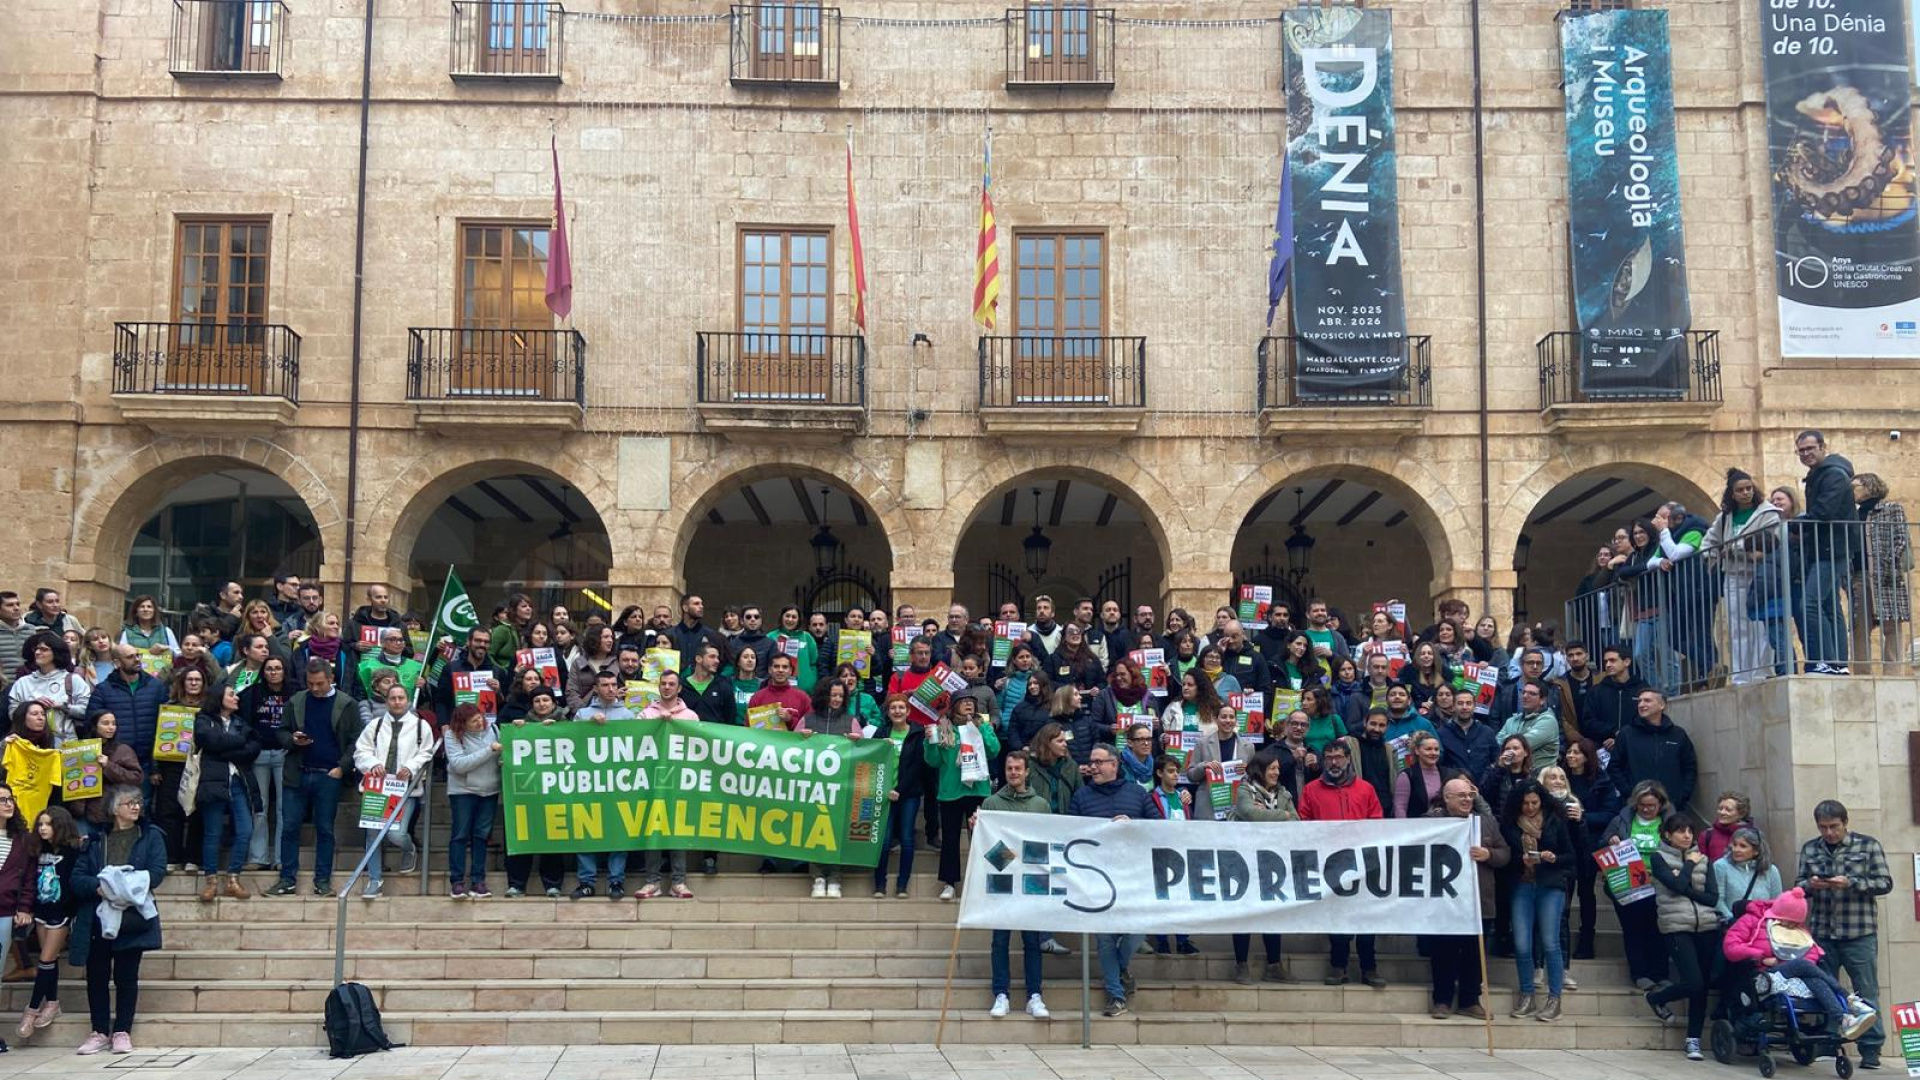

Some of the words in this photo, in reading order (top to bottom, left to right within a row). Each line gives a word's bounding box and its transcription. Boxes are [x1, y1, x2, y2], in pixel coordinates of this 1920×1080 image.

[1772, 13, 1817, 32] Una
[1823, 12, 1886, 33] Dénia
[1773, 36, 1802, 55] de
[1808, 36, 1839, 55] 10.
[1592, 59, 1616, 157] Museu
[1621, 45, 1653, 229] Arqueologia
[1302, 47, 1382, 266] DÉNIA
[1832, 256, 1852, 265] Anys
[1881, 264, 1913, 272] Creativa
[1785, 256, 1829, 289] 10
[1833, 280, 1869, 288] UNESCO
[1318, 305, 1348, 315] NOV.
[1352, 305, 1382, 314] 2025
[1318, 317, 1347, 326] ABR.
[1351, 317, 1381, 326] 2026
[1303, 331, 1356, 340] EXPOSICIÓ
[1243, 587, 1253, 599] 11
[997, 624, 1007, 636] 11
[520, 652, 533, 665] 11
[934, 665, 949, 680] 11
[1467, 665, 1478, 679] 11
[456, 675, 469, 689] 11
[1231, 694, 1242, 710] 11
[1169, 734, 1179, 746] 11
[512, 739, 576, 767] PER
[588, 735, 659, 764] UNA
[668, 732, 841, 776] EDUCACIÓ
[368, 776, 381, 790] 11
[541, 764, 650, 795] PÚBLICA
[679, 768, 712, 792] DE
[719, 770, 841, 806] QUALITAT
[875, 762, 886, 803] GORGOS
[874, 804, 882, 817] DE
[515, 804, 529, 841] I
[545, 803, 604, 840] EN
[616, 799, 838, 852] VALENCIÀ
[870, 820, 880, 844] GATA
[1599, 851, 1615, 867] 11
[1616, 845, 1636, 857] VAGA
[1151, 844, 1463, 903] PEDREGUER
[1896, 1006, 1916, 1026] 11
